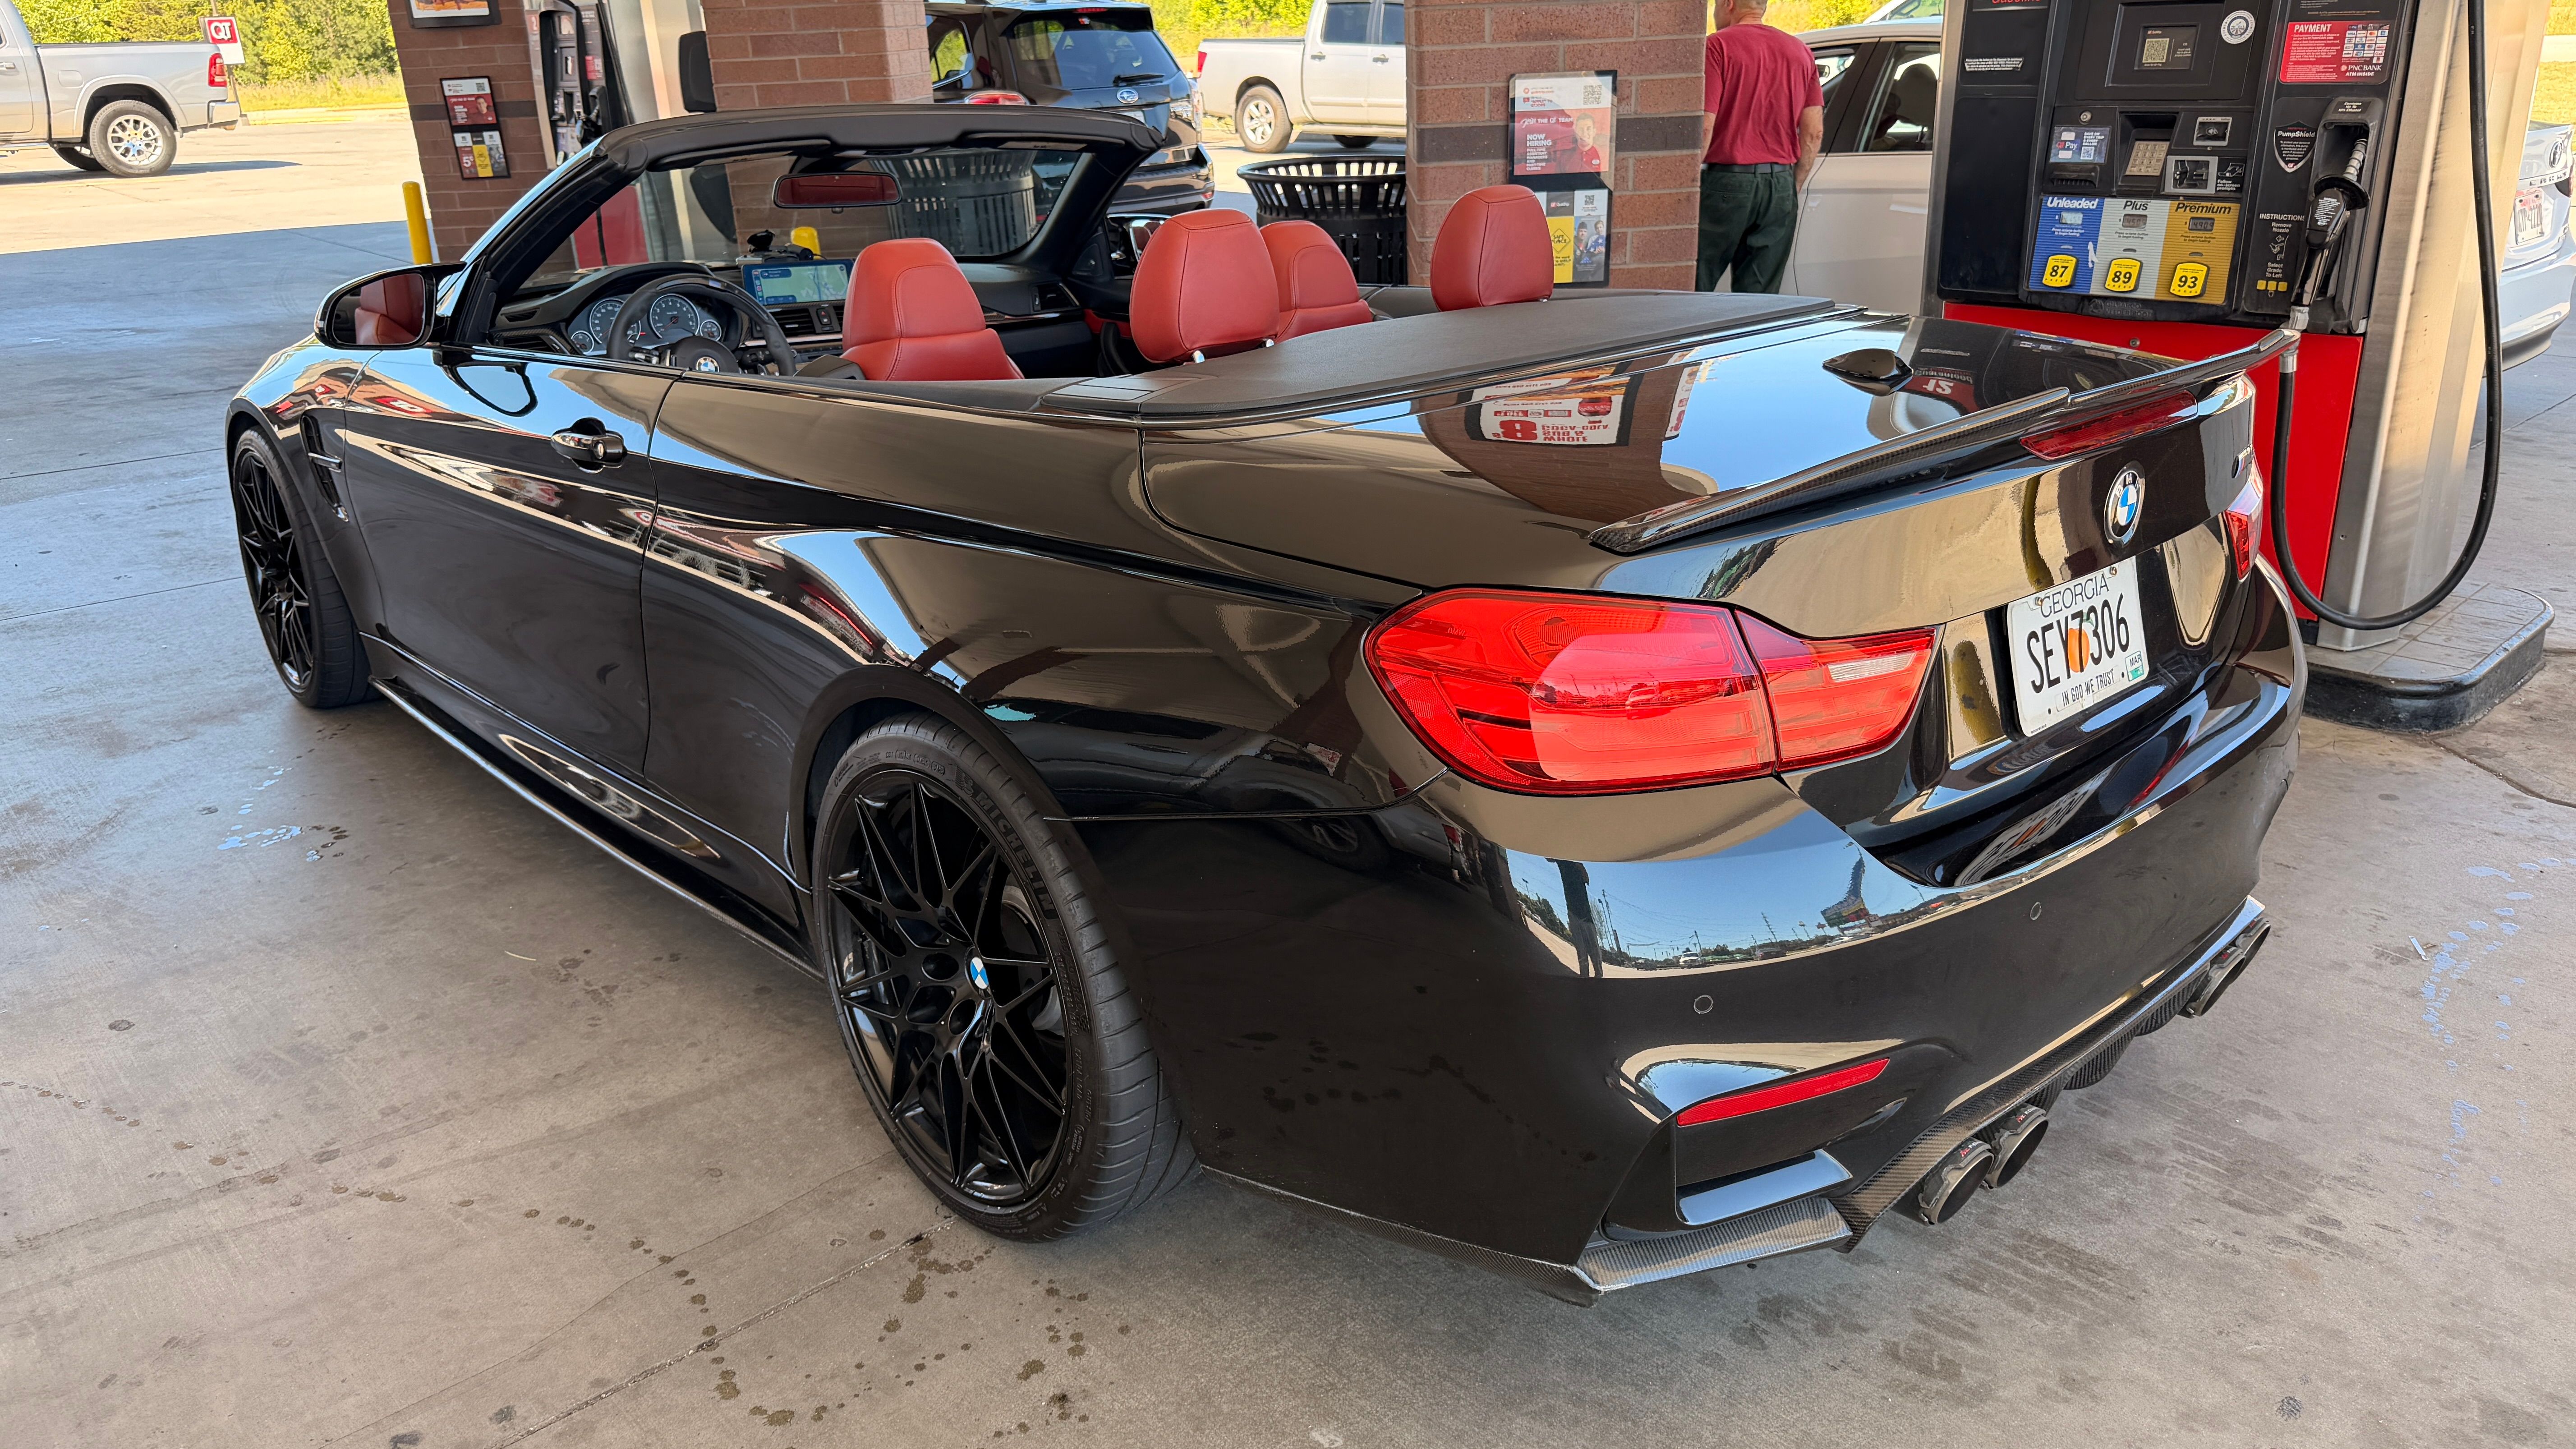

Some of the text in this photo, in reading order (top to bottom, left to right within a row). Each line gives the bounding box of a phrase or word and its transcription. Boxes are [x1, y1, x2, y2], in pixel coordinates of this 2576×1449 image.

[211, 22, 231, 41] QT
[2294, 24, 2332, 32] PAYMENT
[2065, 141, 2078, 151] Pay
[2047, 197, 2099, 209] Unleaded
[2123, 200, 2148, 211] Plus
[2175, 202, 2231, 214] Premium
[2049, 265, 2069, 278] 87
[2111, 271, 2133, 284] 89
[2177, 275, 2199, 289] 93
[2040, 573, 2110, 618] GEORGIA
[2026, 592, 2130, 694] SEY7306
[2130, 653, 2142, 667] MAR
[2061, 668, 2115, 707] IN GOD WE TRUST
[975, 792, 1055, 912] MICHELIN
